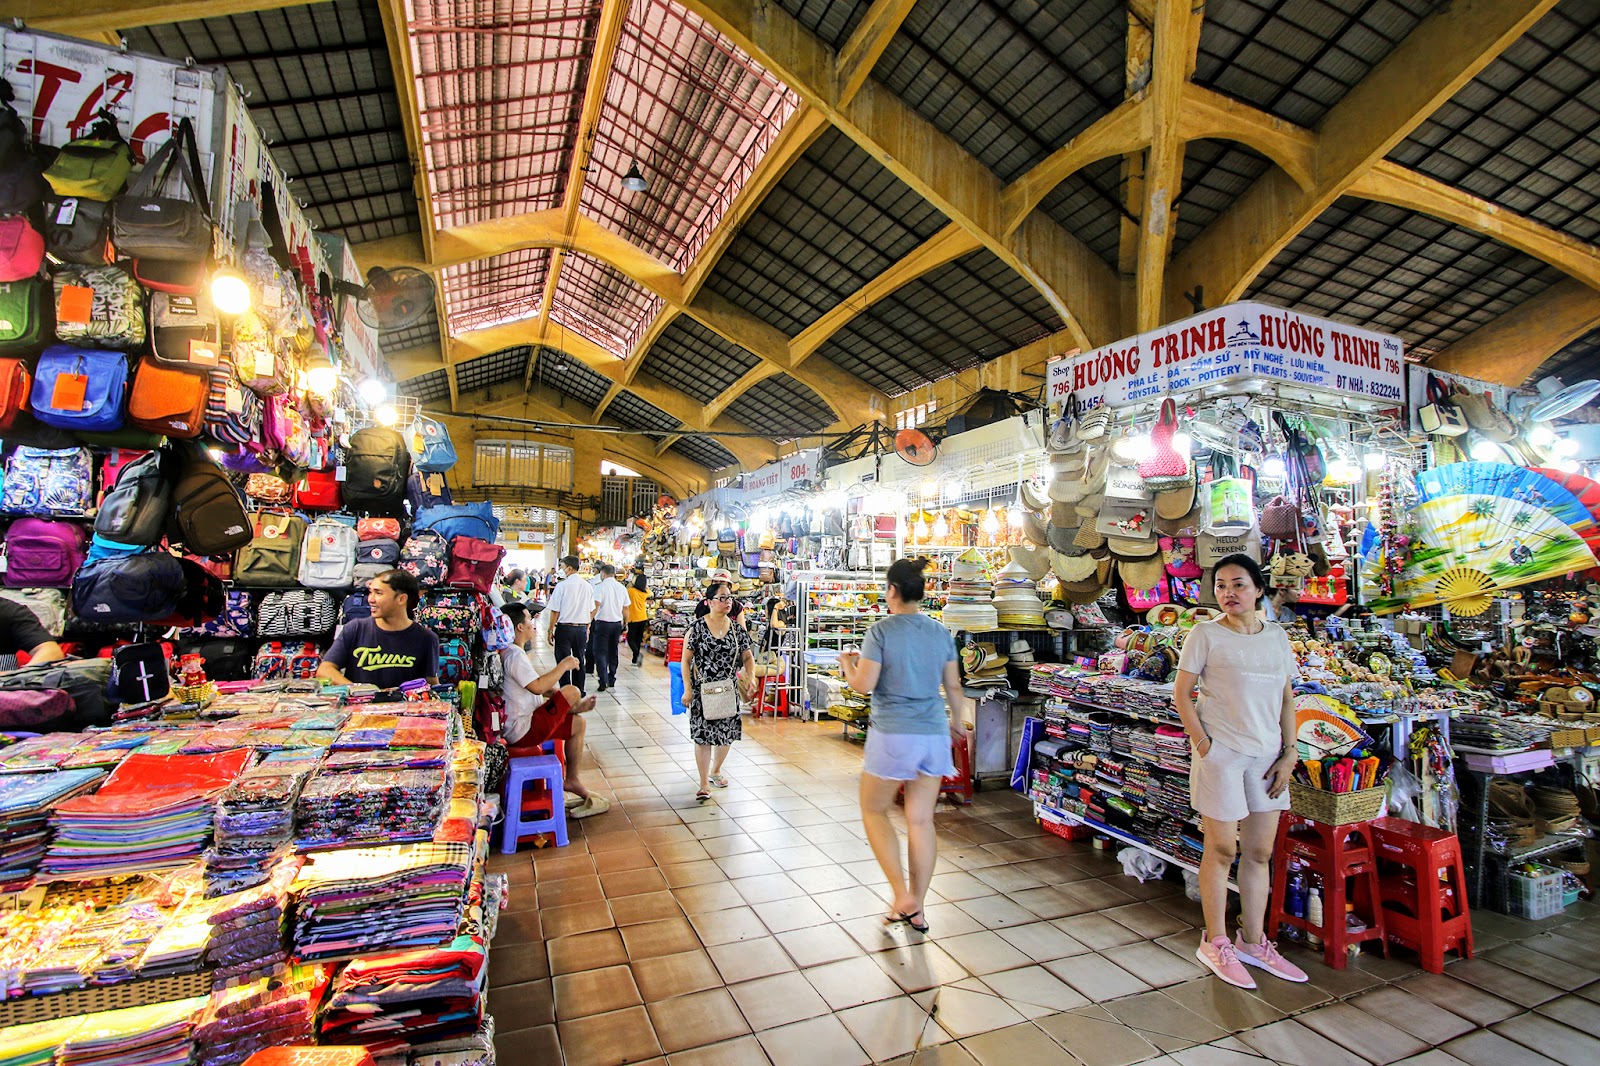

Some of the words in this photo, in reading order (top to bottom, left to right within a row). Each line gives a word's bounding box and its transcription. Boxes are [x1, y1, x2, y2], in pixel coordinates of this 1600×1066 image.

[1259, 311, 1325, 358] HƯƠNG
[1330, 330, 1381, 370] TRINH
[1383, 338, 1399, 356] Shop
[1073, 346, 1141, 392] HƯƠNG
[1150, 317, 1227, 368] TRINH
[1052, 365, 1070, 377] Shop
[1128, 377, 1145, 389] PHA
[1147, 372, 1159, 384] LÊ
[1215, 349, 1231, 364] SỨ
[1243, 348, 1261, 360] MỸ
[1263, 352, 1284, 367] NGHỆ
[1384, 357, 1400, 375] 796
[1052, 380, 1070, 397] 796
[1127, 385, 1161, 400] CRYSTAL
[1168, 377, 1191, 390] ROCK
[1199, 364, 1241, 382] POTTERY
[1253, 363, 1270, 375] FINE
[1270, 366, 1288, 378] ARTS
[1336, 374, 1347, 389] ĐT
[1348, 375, 1364, 393] NHÀ
[1370, 381, 1400, 400] 8322244
[1076, 395, 1105, 412] 01454
[790, 463, 806, 480] 804
[1112, 482, 1146, 491] SUNDAY
[1209, 544, 1248, 553] WEEKEND
[1216, 536, 1239, 544] HELLO
